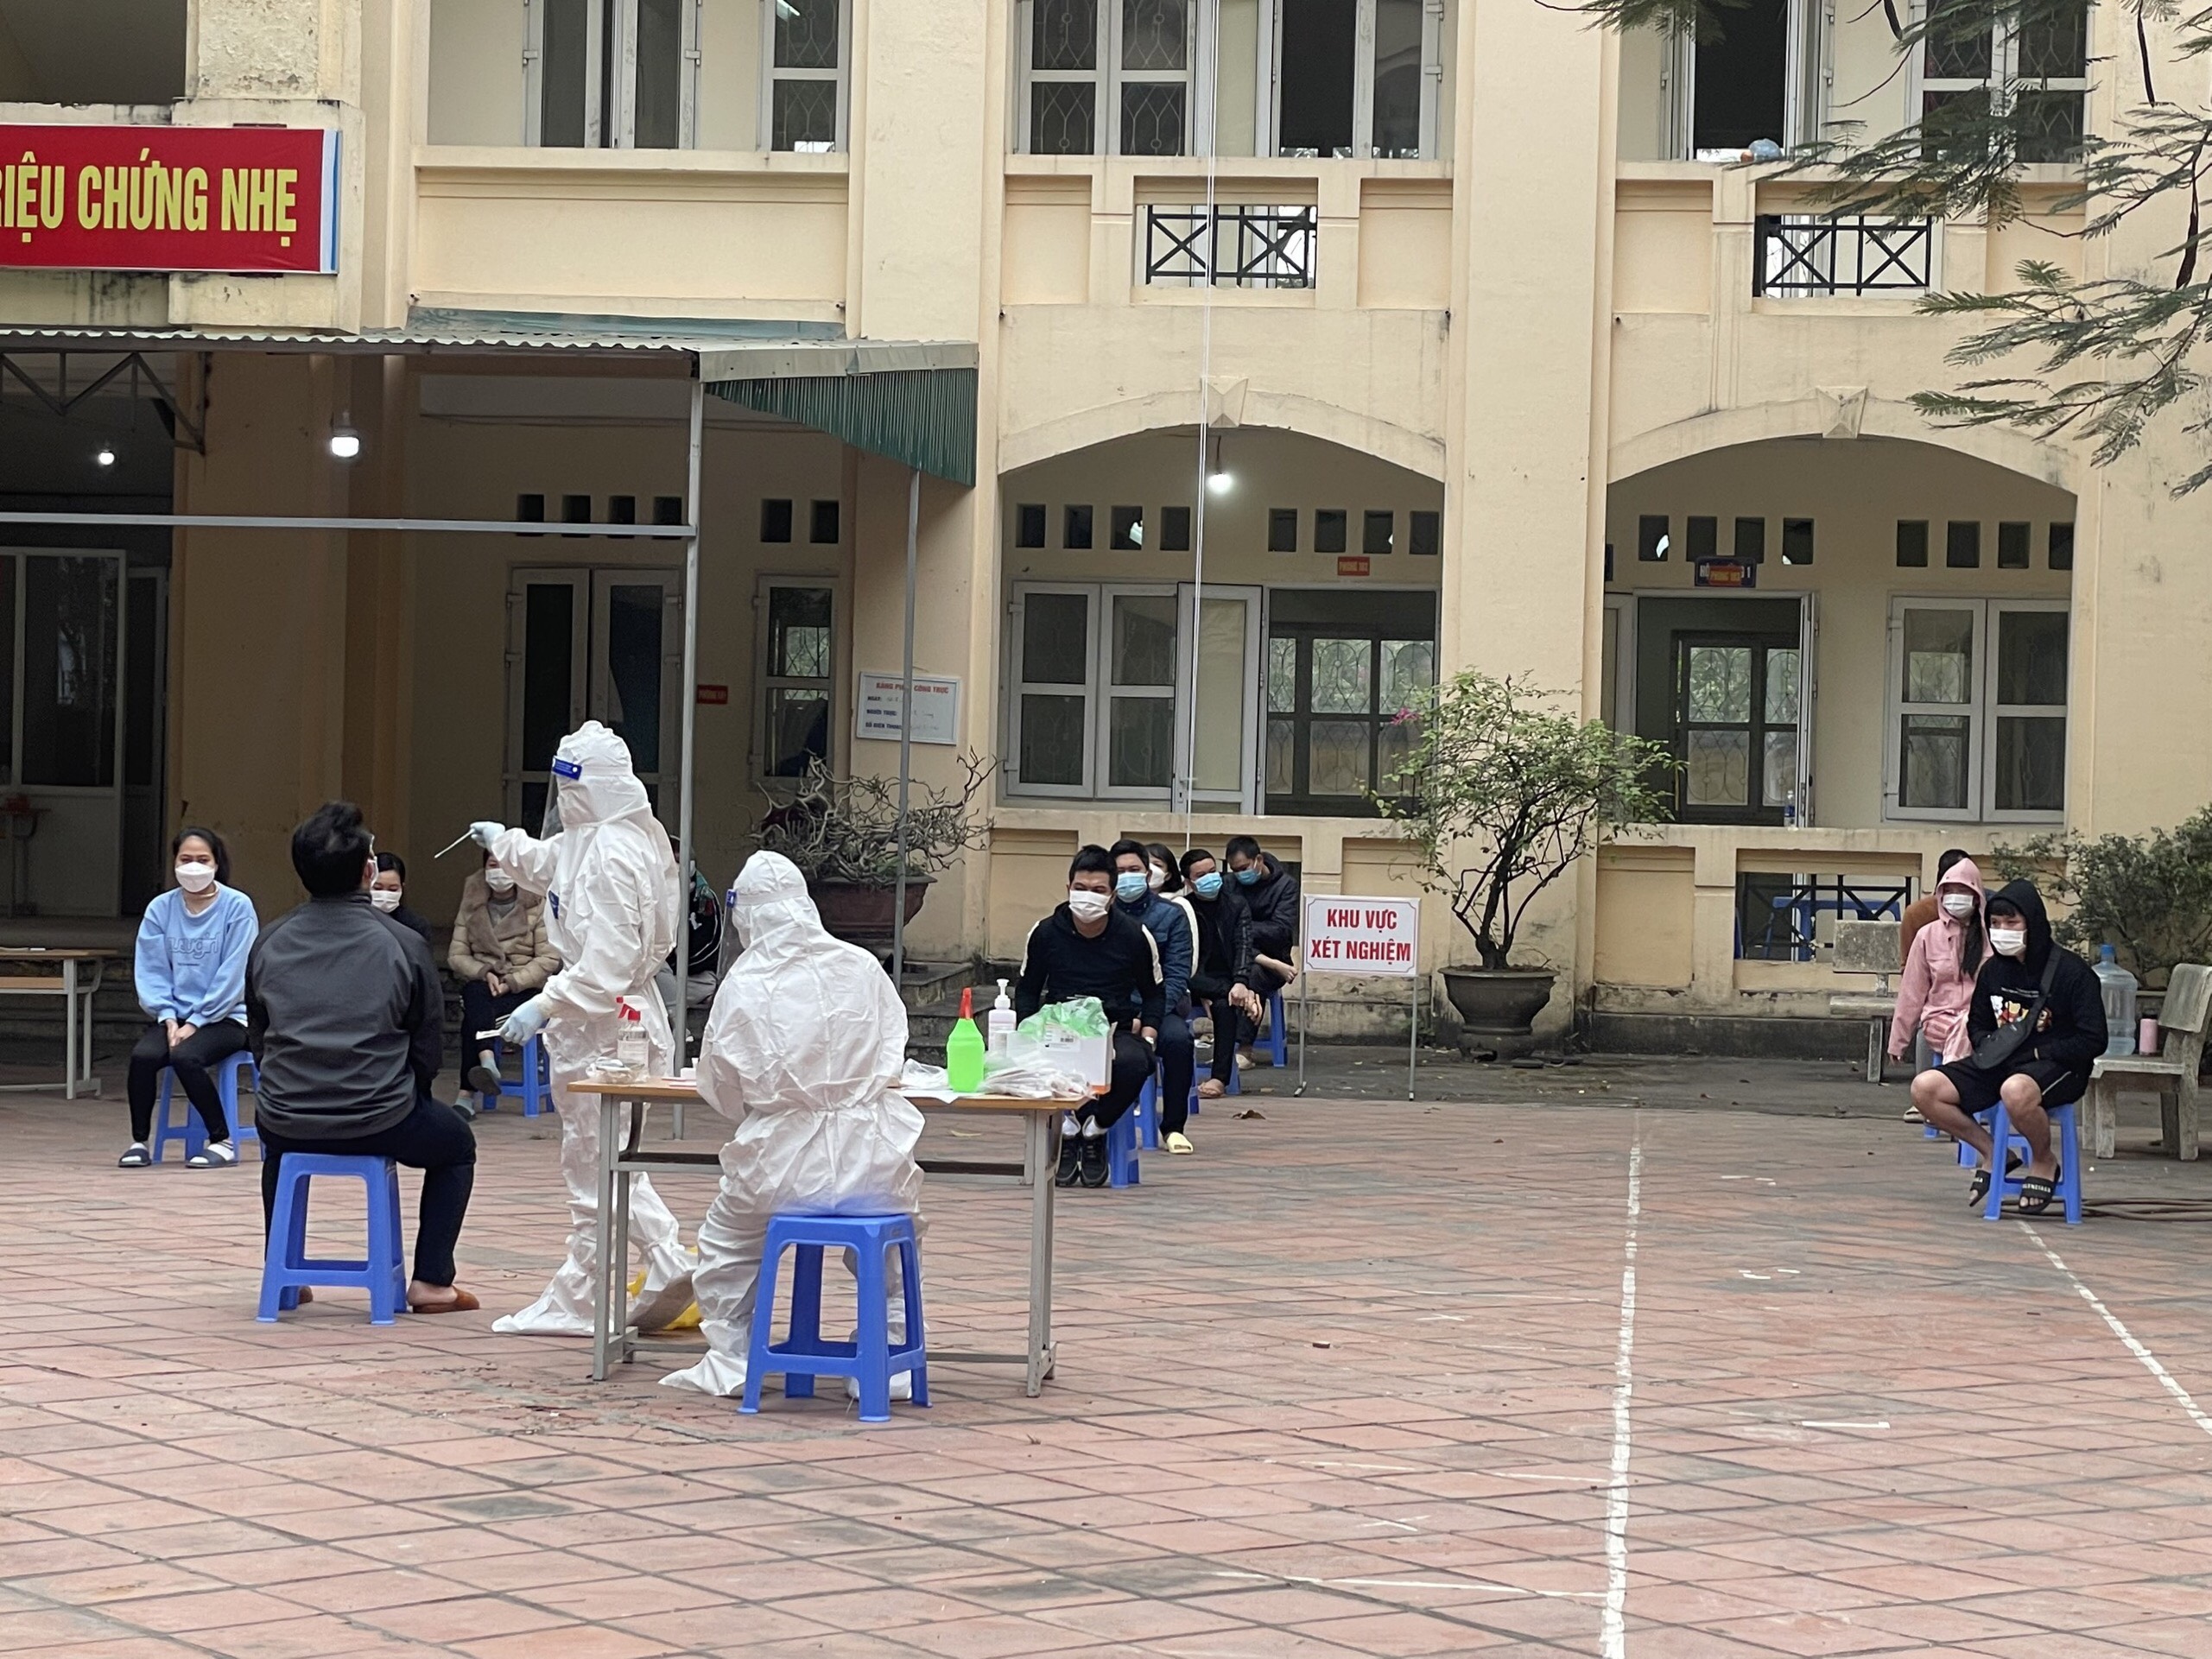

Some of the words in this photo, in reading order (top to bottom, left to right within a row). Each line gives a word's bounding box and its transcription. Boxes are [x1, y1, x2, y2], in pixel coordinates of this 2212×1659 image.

[0, 151, 65, 244] IỆU
[78, 148, 209, 231] CHỨNG
[221, 168, 298, 247] NHẸ
[1327, 908, 1360, 928] KHU
[1366, 908, 1398, 933] VỰC
[1311, 936, 1341, 959] XÉT
[1347, 938, 1411, 966] NGHIỆM
